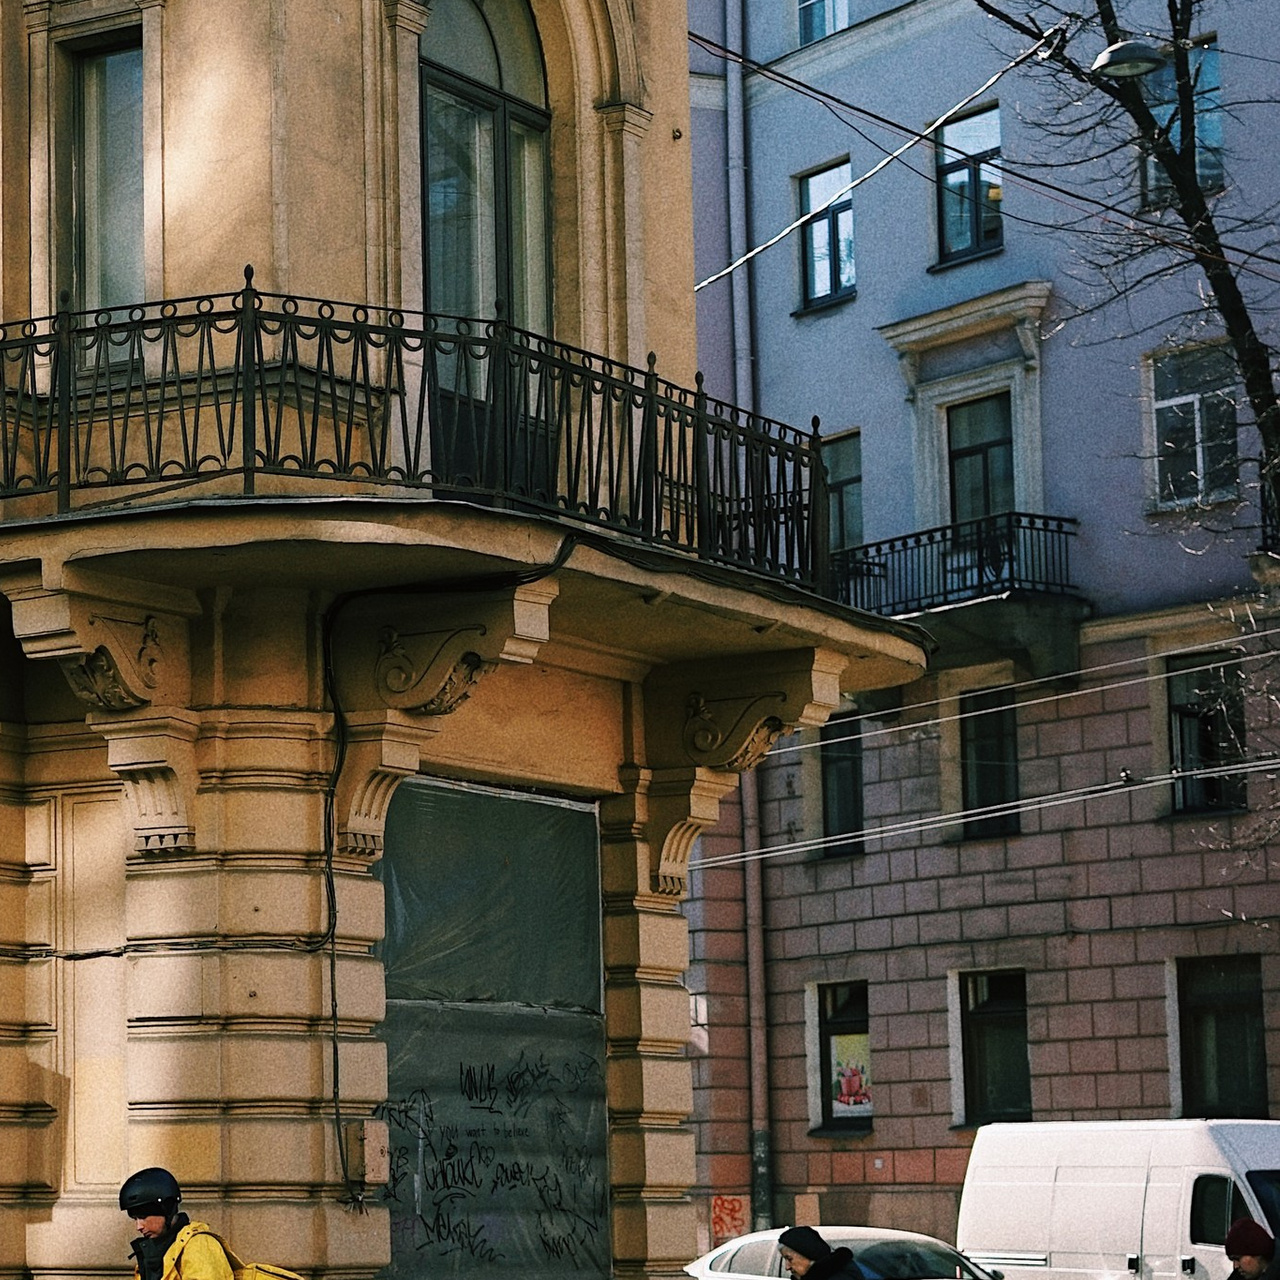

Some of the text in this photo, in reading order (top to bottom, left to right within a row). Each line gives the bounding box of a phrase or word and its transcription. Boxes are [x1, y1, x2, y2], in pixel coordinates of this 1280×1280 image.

[466, 1123, 487, 1138] want
[493, 1121, 501, 1136] to
[504, 1122, 530, 1138] believe
